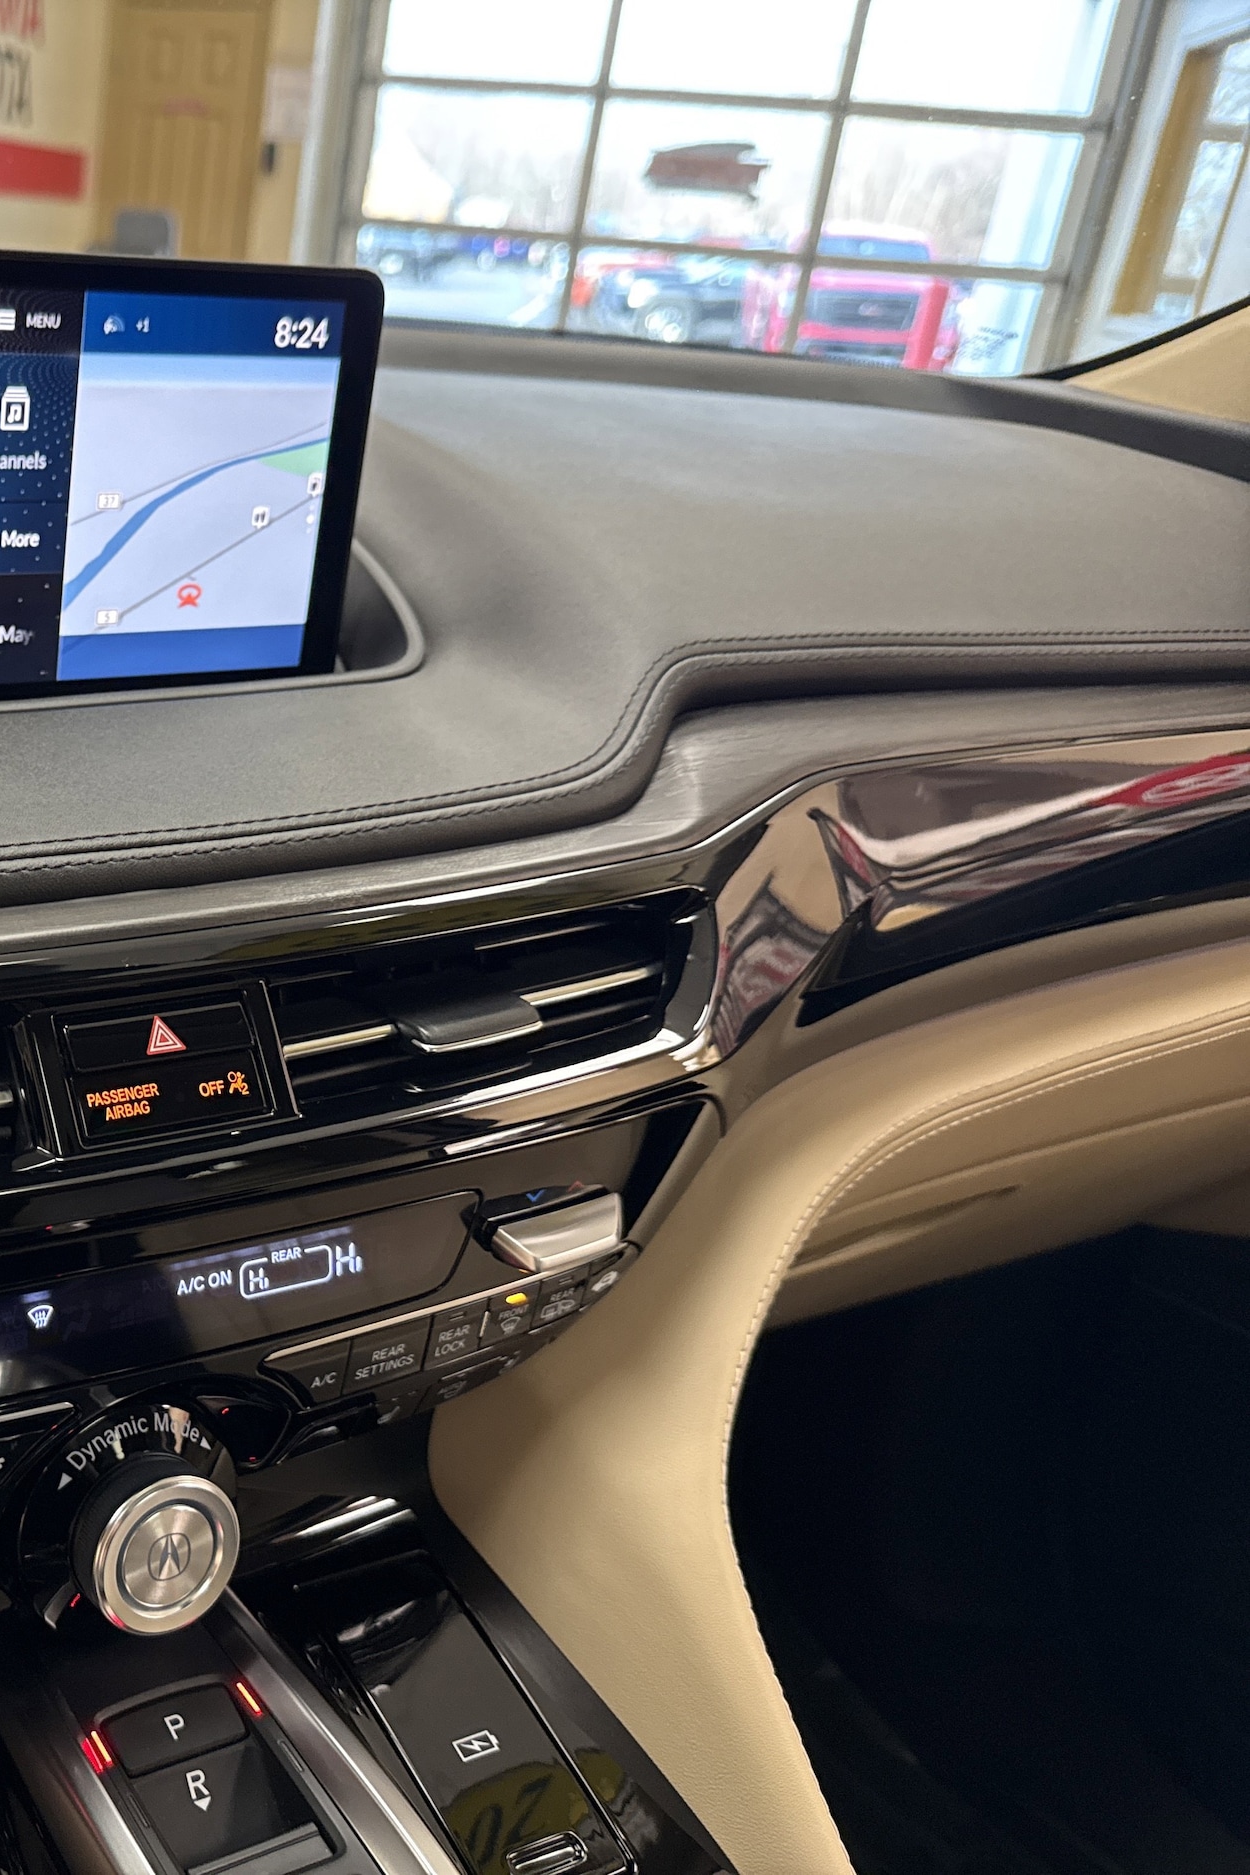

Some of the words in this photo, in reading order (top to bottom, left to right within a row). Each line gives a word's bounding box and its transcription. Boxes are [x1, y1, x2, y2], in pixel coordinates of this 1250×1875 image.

[25, 311, 61, 329] MENU
[273, 314, 330, 350] 8:24
[0, 529, 41, 549] More
[86, 1082, 160, 1108] PASSENGER
[199, 1080, 225, 1097] OFF
[105, 1100, 151, 1121] AIRBAG
[271, 1246, 302, 1264] REAR
[176, 1275, 206, 1296] A/C
[208, 1269, 233, 1289] ON
[551, 1287, 575, 1302] REAR
[498, 1304, 530, 1321] FRONT
[438, 1324, 471, 1343] REAR
[371, 1342, 406, 1362] REAR
[434, 1339, 467, 1357] LOCK
[354, 1353, 415, 1381] SETTINGS
[310, 1372, 337, 1390] A/C
[65, 1415, 150, 1472] Dynamic
[153, 1411, 201, 1444] Mode
[163, 1713, 185, 1741] P
[185, 1768, 210, 1800] R
